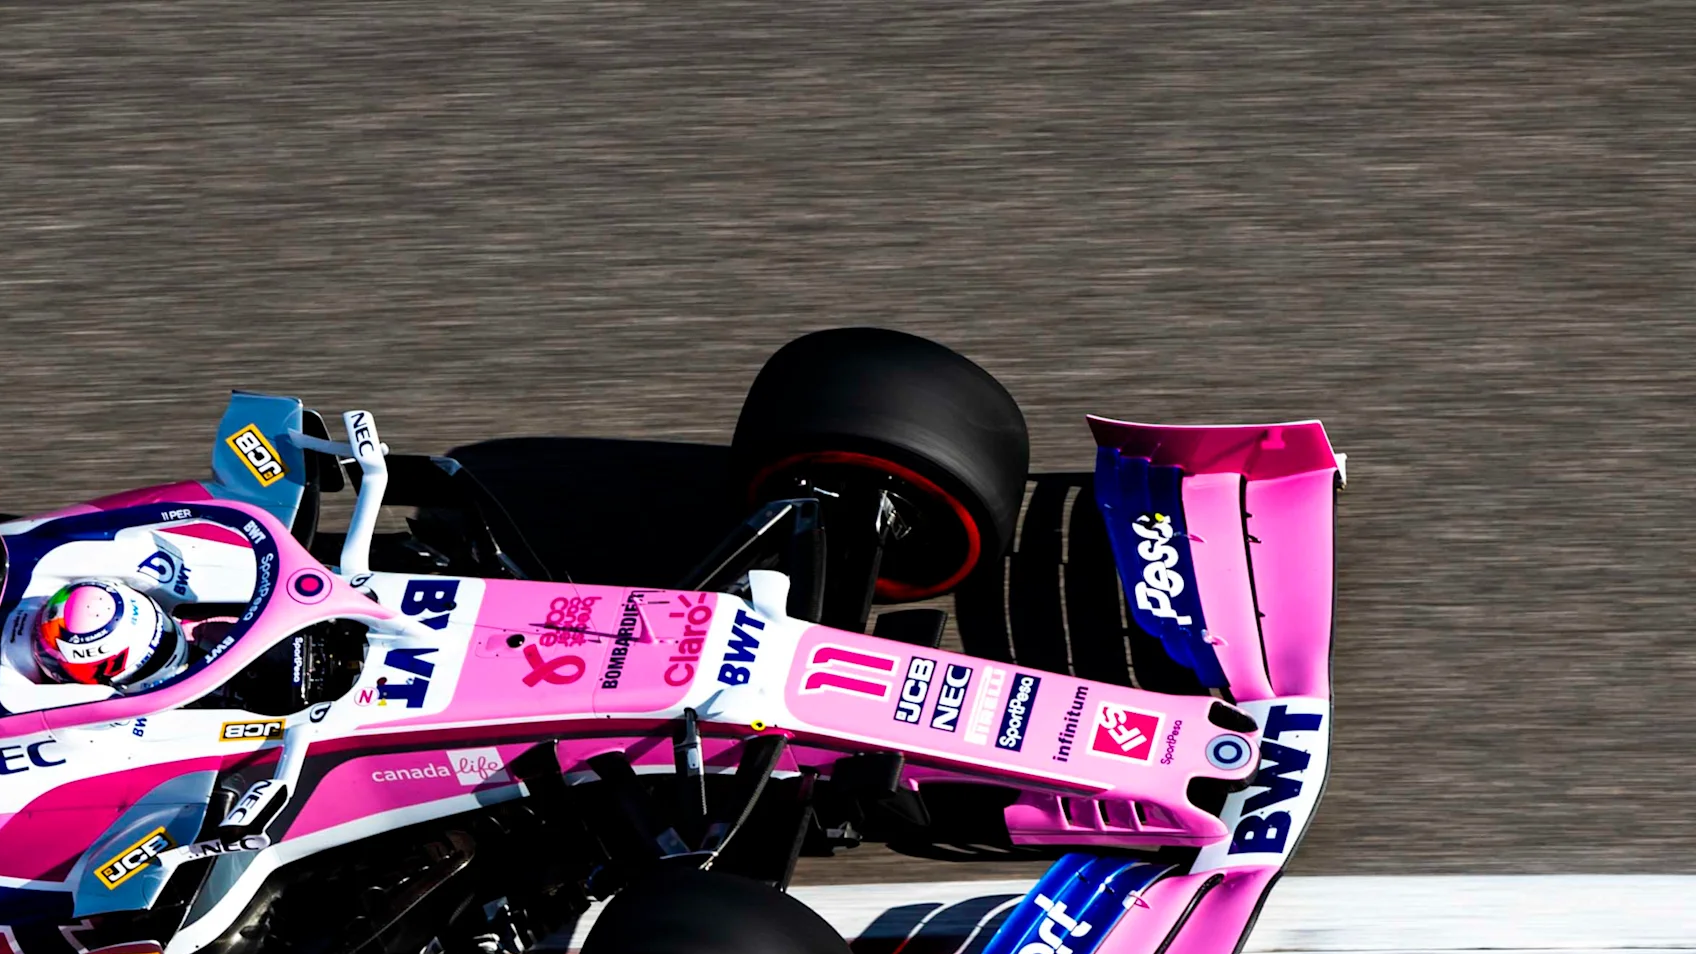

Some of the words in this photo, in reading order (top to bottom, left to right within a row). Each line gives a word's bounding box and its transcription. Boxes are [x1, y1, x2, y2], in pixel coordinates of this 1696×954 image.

[236, 431, 282, 476] JCB
[351, 412, 374, 457] NEC
[169, 508, 192, 519] PER
[243, 520, 266, 544] BWT
[174, 563, 191, 596] BWT
[243, 553, 274, 621] SportPesa
[72, 644, 110, 659] NEC
[205, 635, 235, 664] BWT
[664, 603, 712, 687] Claro
[717, 609, 765, 686] BWT
[800, 643, 899, 700] 11
[902, 658, 935, 723] JCB
[359, 689, 373, 703] N
[932, 666, 971, 731] NEC
[999, 676, 1034, 748] SportPesa
[133, 717, 147, 737] BW
[225, 723, 280, 737] JCB
[1053, 686, 1089, 762] infinitum
[1100, 705, 1147, 752] IFS
[1161, 720, 1182, 765] SportPesa
[372, 763, 451, 782] canada
[456, 756, 498, 781] life
[1227, 705, 1323, 855] BWT
[228, 781, 272, 823] NEC
[107, 834, 168, 881] JCB
